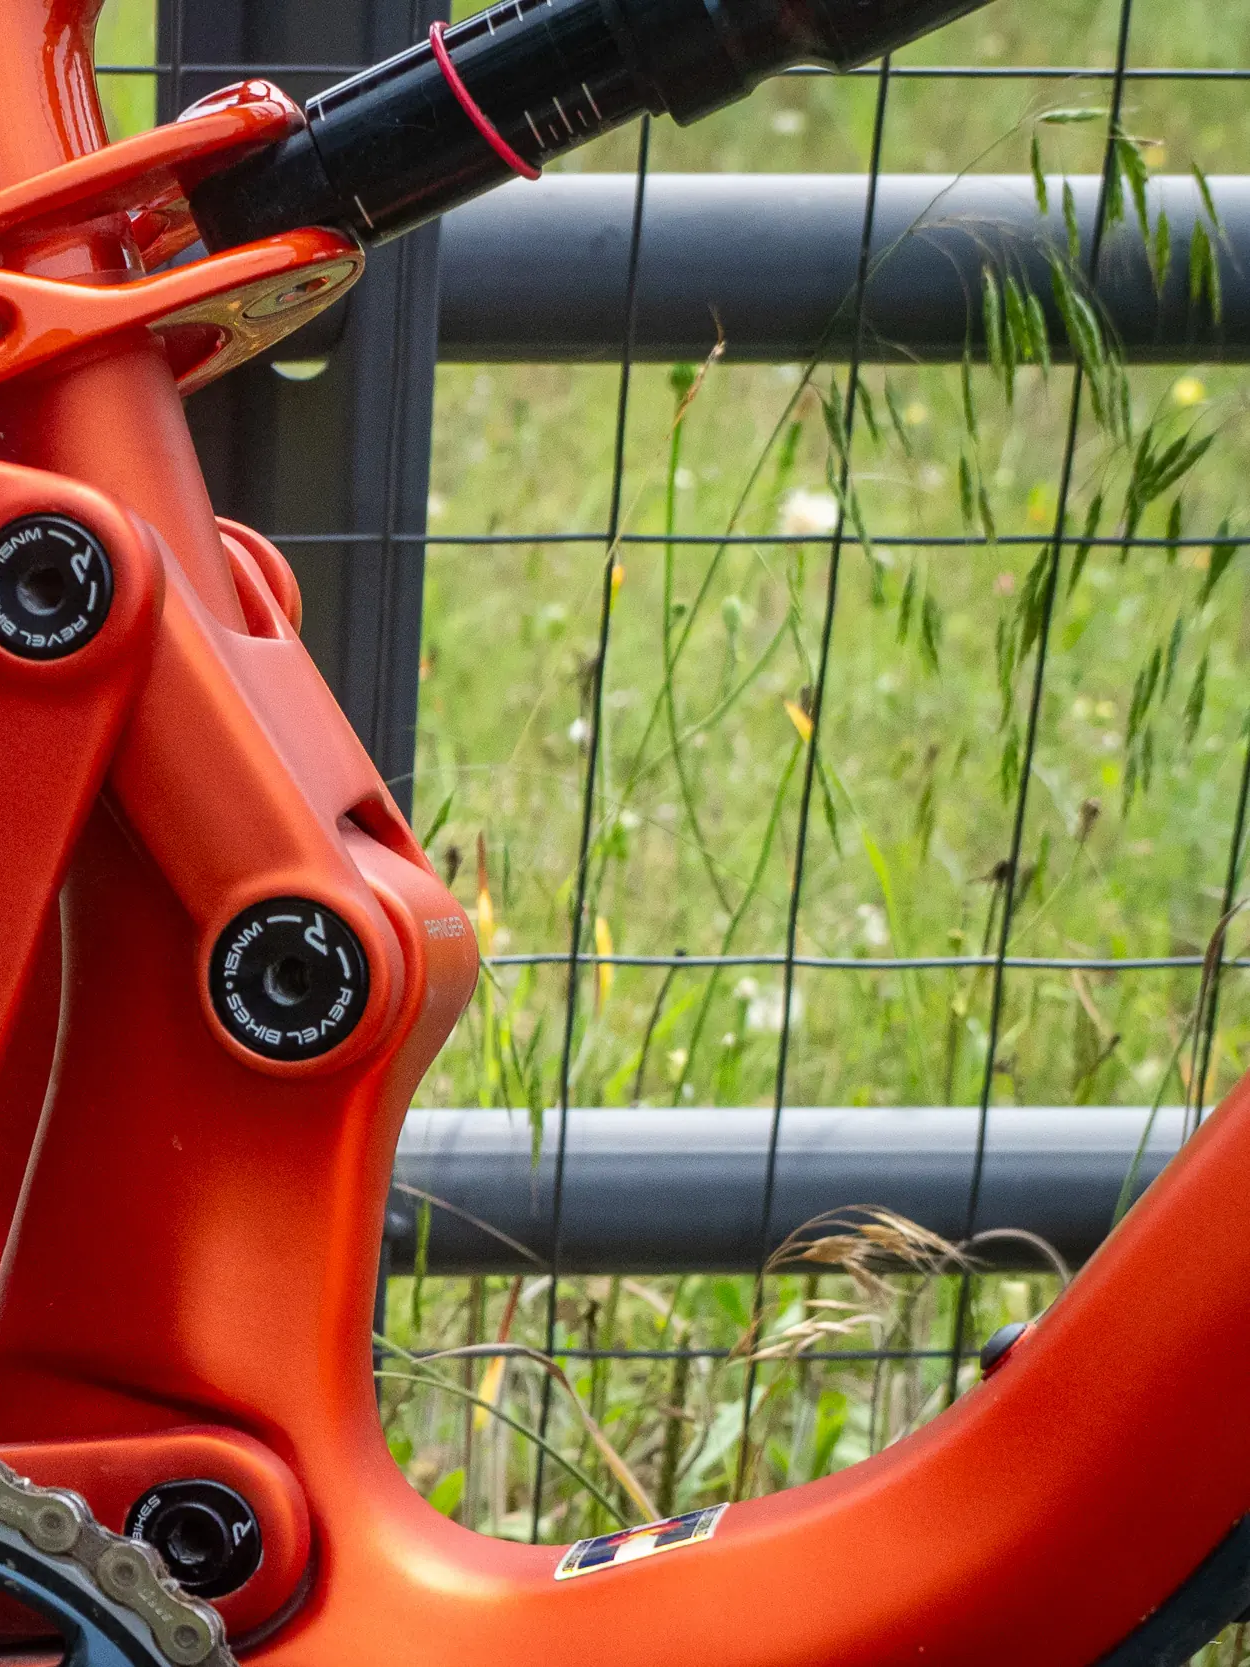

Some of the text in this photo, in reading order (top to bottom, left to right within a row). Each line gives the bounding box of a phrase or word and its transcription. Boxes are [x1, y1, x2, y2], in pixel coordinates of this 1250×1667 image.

[19, 614, 89, 648] REVEL
[223, 921, 353, 1046] REVEL BIKES 15NM
[132, 1494, 161, 1540] BIKES
